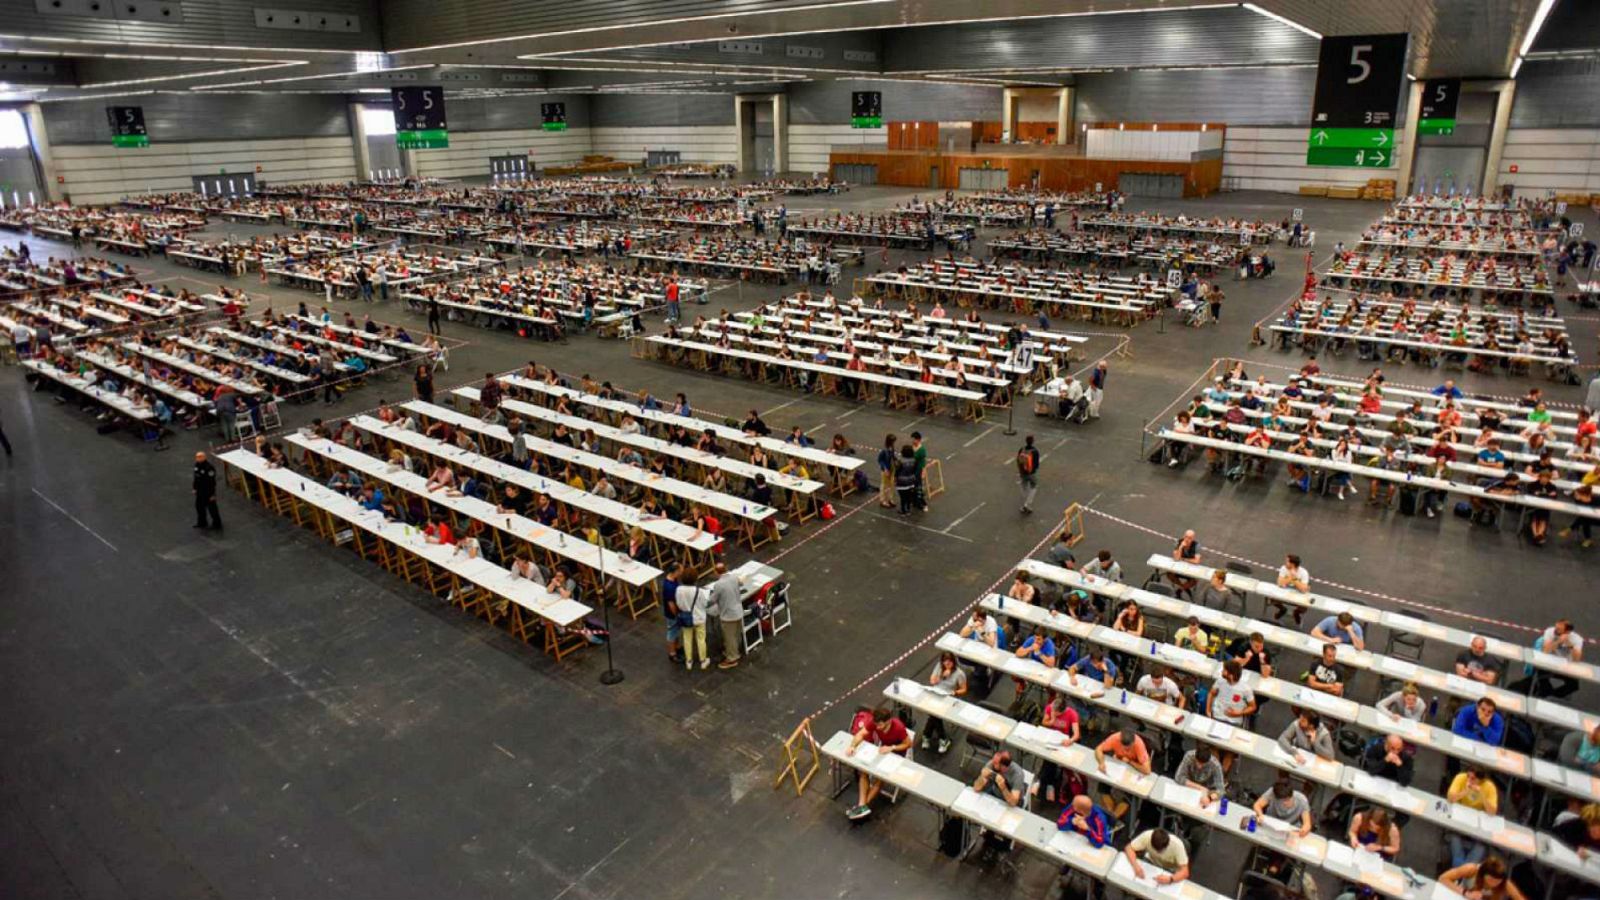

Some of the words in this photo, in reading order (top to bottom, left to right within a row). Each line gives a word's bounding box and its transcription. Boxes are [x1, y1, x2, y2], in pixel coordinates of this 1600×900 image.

[1347, 44, 1372, 85] 5
[398, 91, 405, 110] 5
[422, 90, 433, 109] 5
[858, 93, 865, 106] 5
[1435, 85, 1447, 102] 5
[125, 109, 135, 123] 5
[1364, 112, 1372, 124] 3
[1017, 347, 1032, 367] 47
